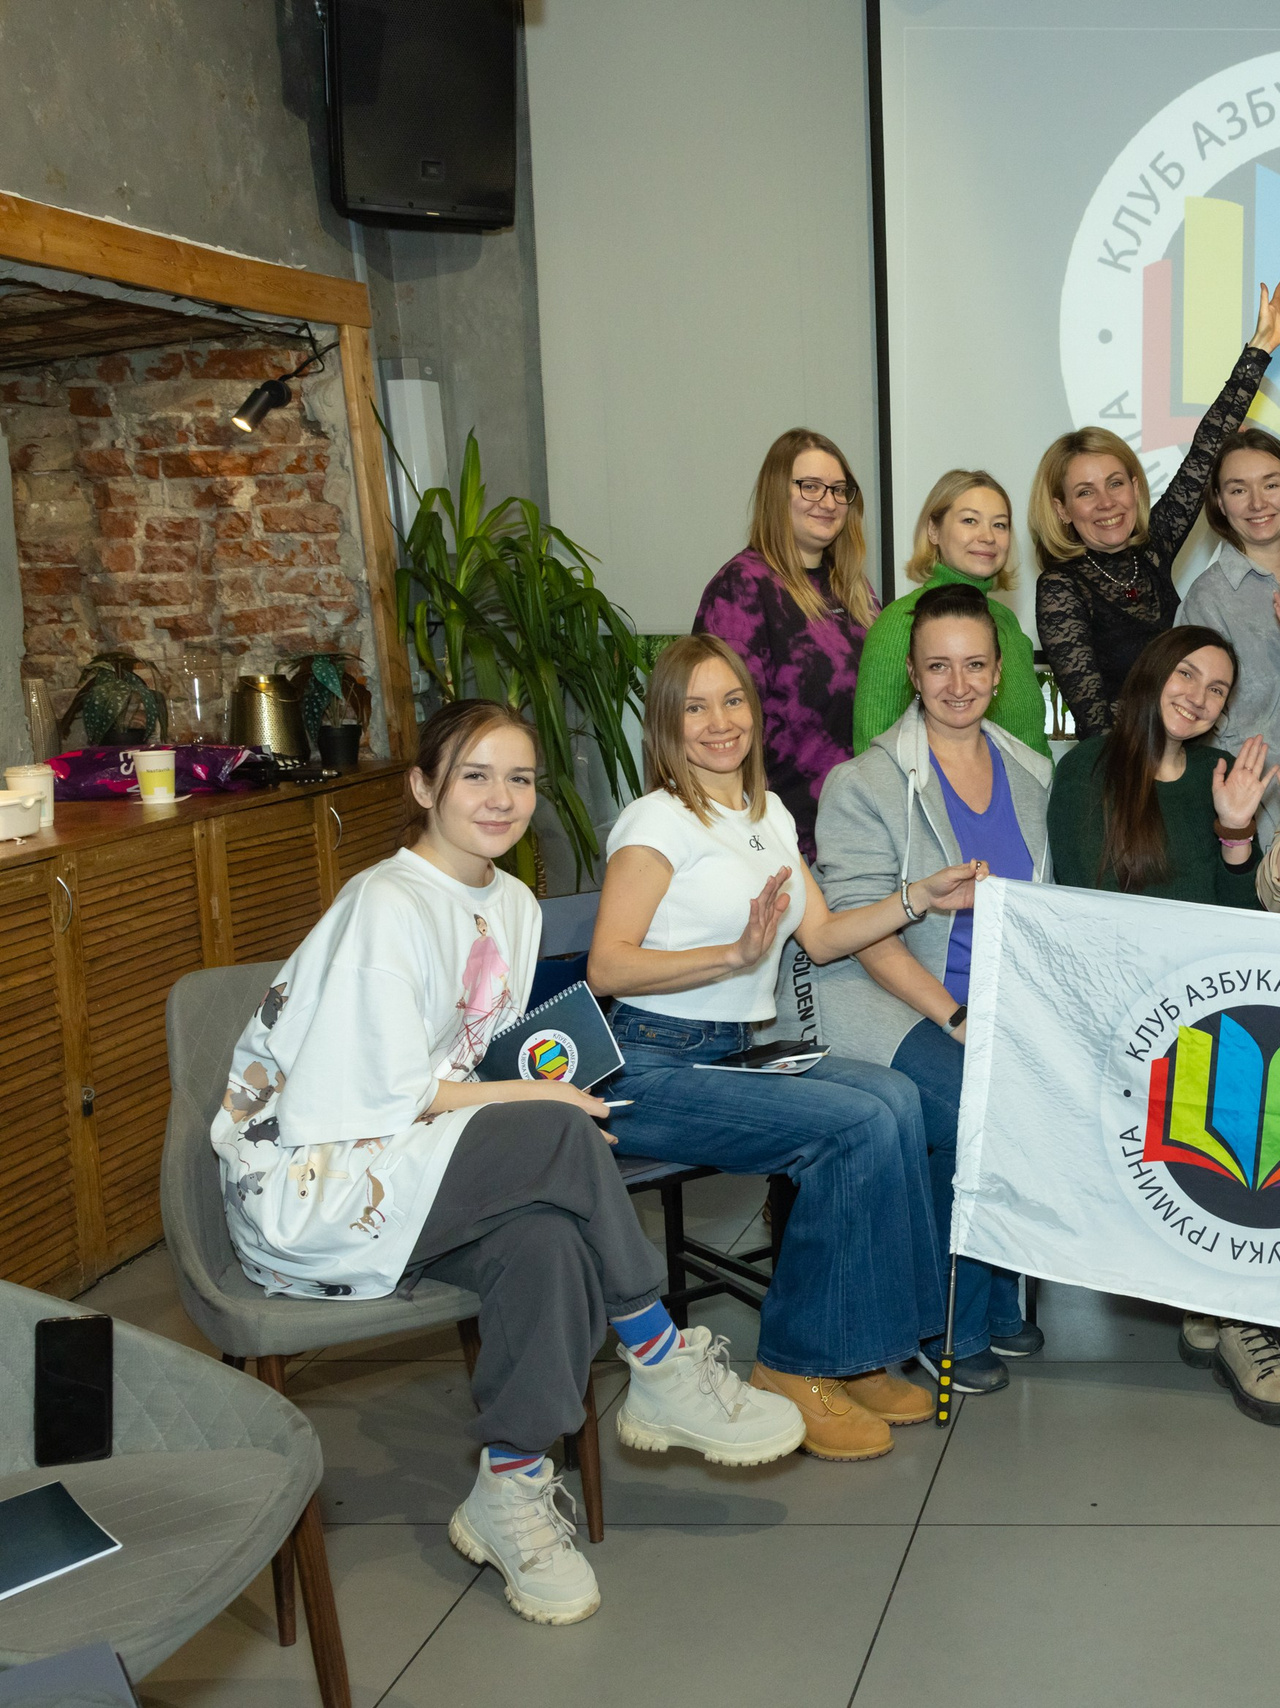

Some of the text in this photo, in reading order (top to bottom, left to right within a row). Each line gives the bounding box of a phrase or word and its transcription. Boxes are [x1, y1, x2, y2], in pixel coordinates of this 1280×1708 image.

[1097, 150, 1186, 273] КЛУБ
[793, 951, 815, 1022] GOLDEN
[1125, 997, 1182, 1063] КЛУБ
[1119, 1125, 1220, 1253] ГРУМИНГА
